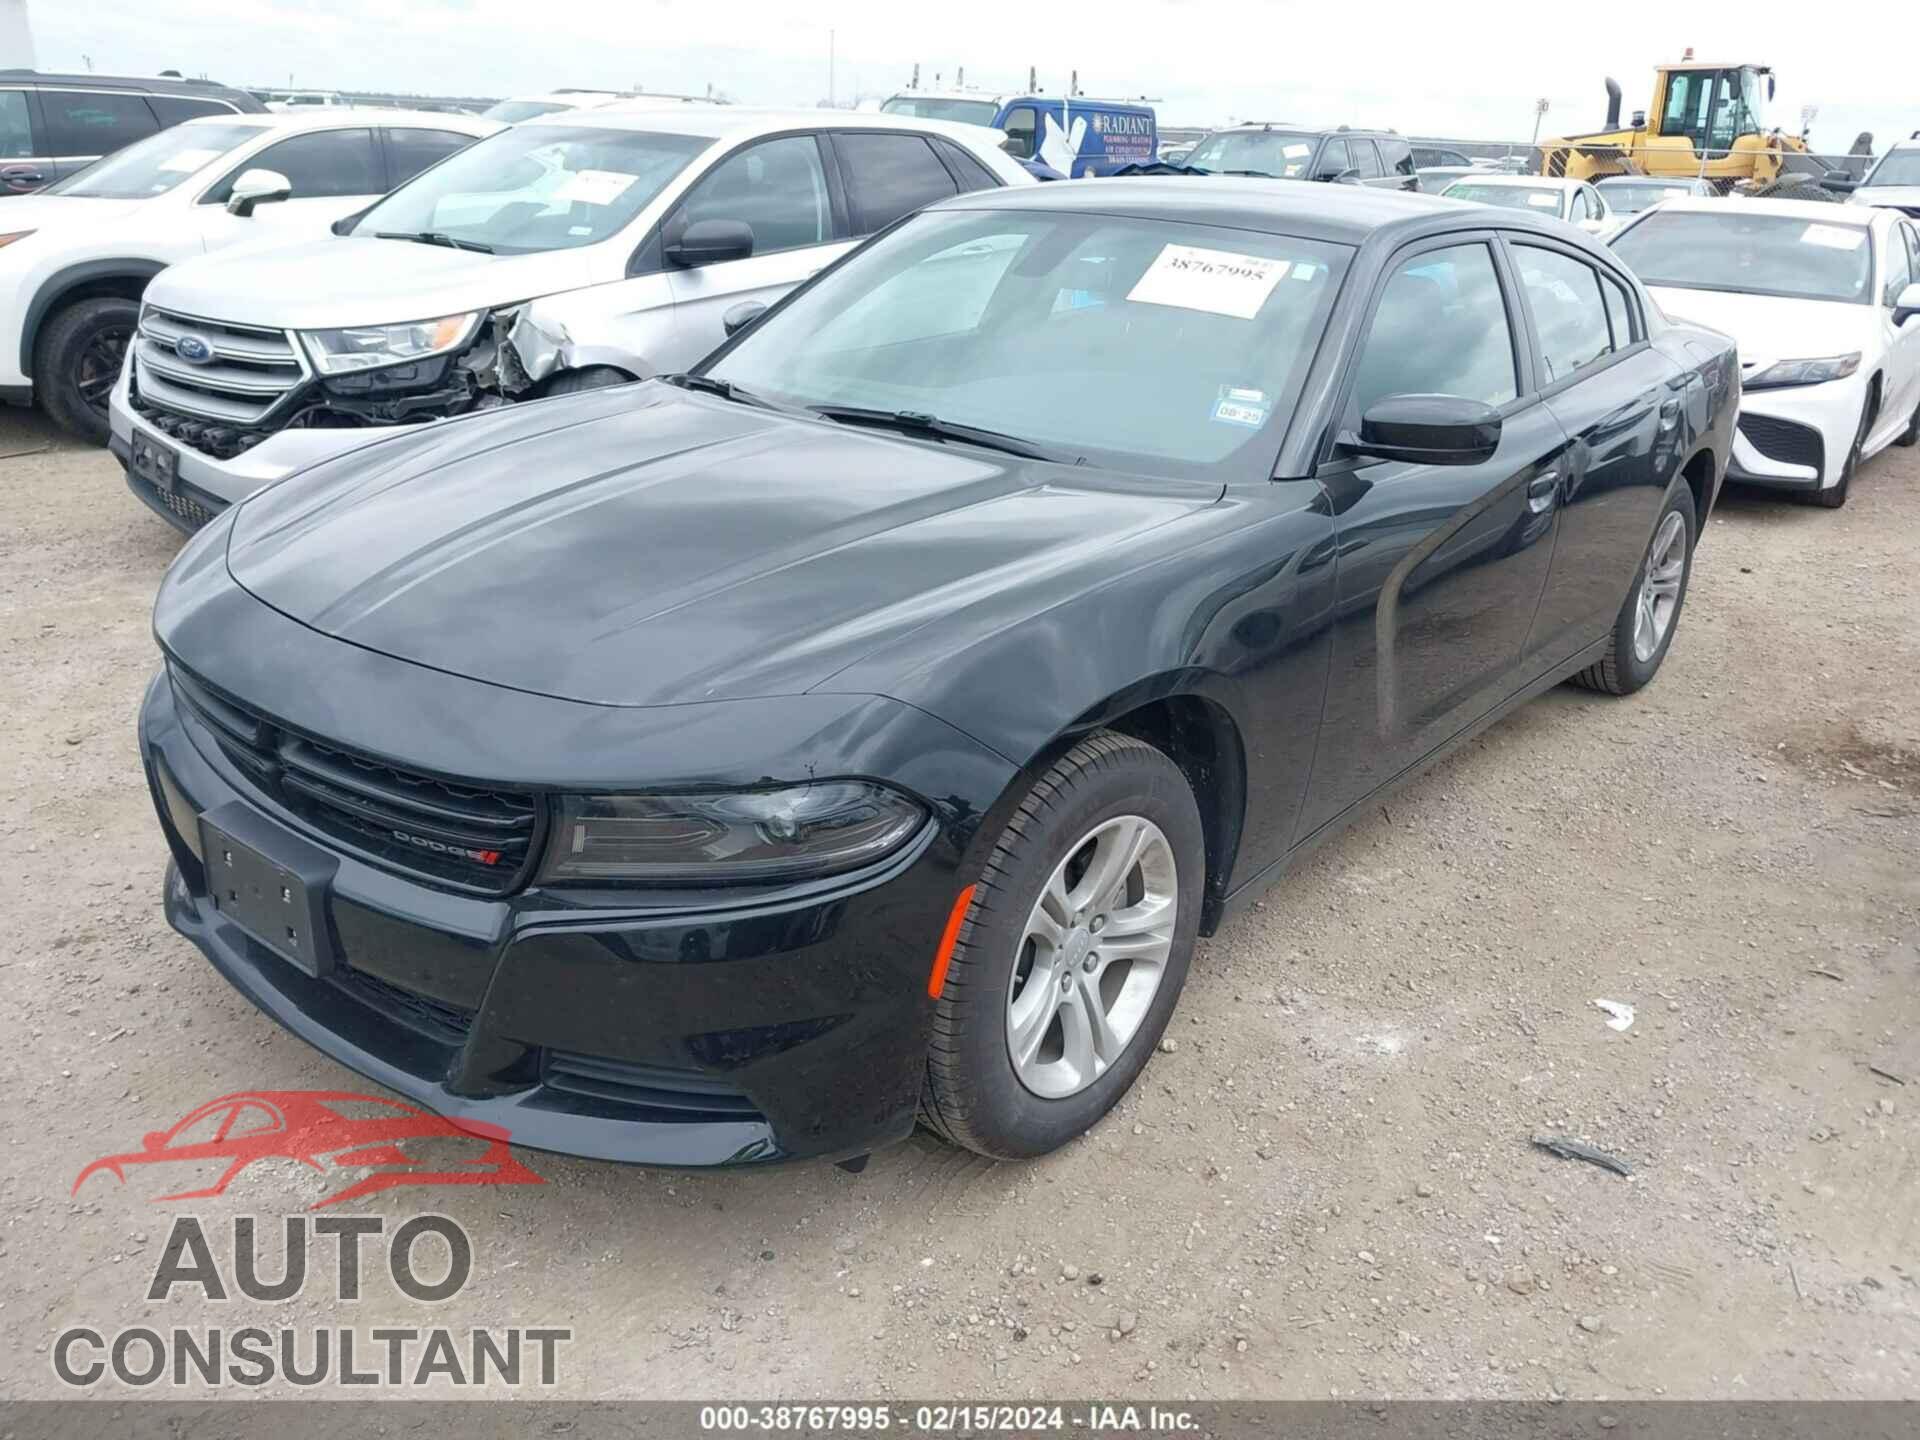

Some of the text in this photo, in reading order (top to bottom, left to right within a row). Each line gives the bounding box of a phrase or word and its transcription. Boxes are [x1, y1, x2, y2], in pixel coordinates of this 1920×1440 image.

[1104, 115, 1153, 134] RADIANT
[1171, 257, 1266, 280] 38767995
[393, 830, 483, 861] DODGE
